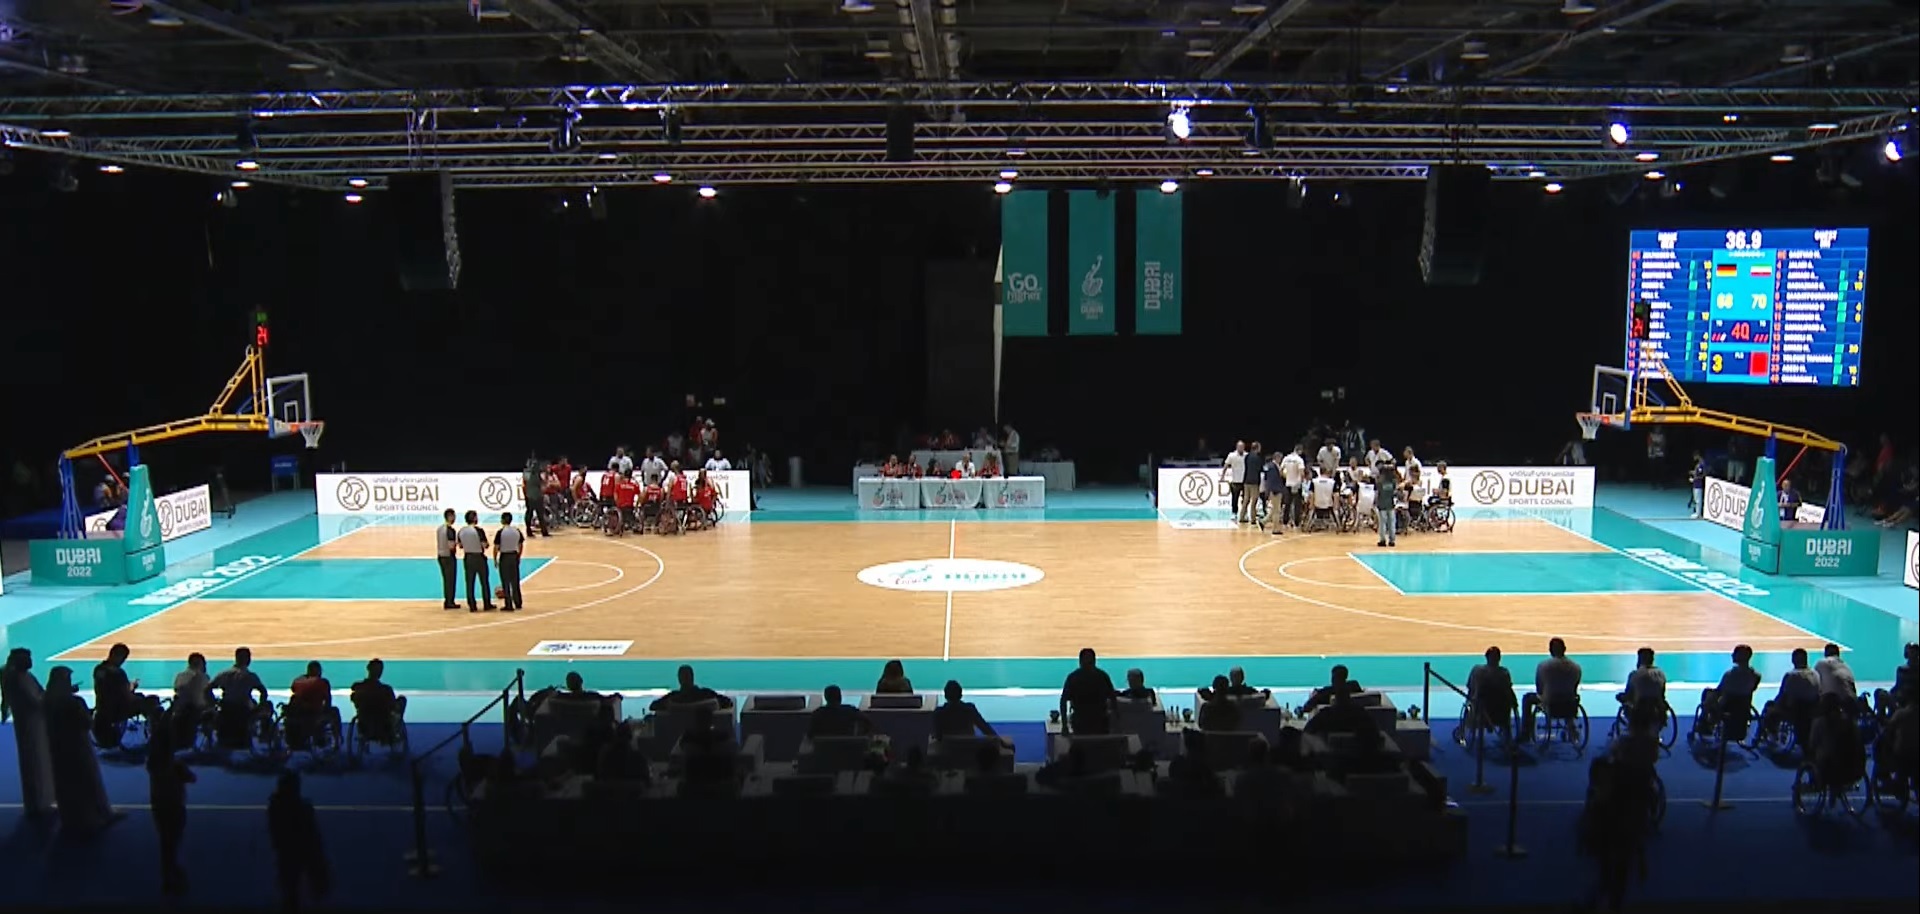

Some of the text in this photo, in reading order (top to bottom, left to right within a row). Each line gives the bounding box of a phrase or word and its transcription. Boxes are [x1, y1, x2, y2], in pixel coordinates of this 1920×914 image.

[1726, 230, 1762, 249] 36.9
[1145, 261, 1160, 309] DUBAI
[1751, 293, 1767, 310] 70
[257, 326, 268, 346] 24
[1712, 354, 1722, 372] 3
[374, 485, 439, 501] DUBAI
[1509, 478, 1574, 495] DUBAI
[175, 497, 207, 523] DUBAI
[1724, 495, 1748, 517] DUB
[1806, 538, 1851, 555] DUBAI
[56, 548, 101, 565] DUBAI
[1815, 557, 1839, 567] 2022
[67, 565, 91, 577] 2022
